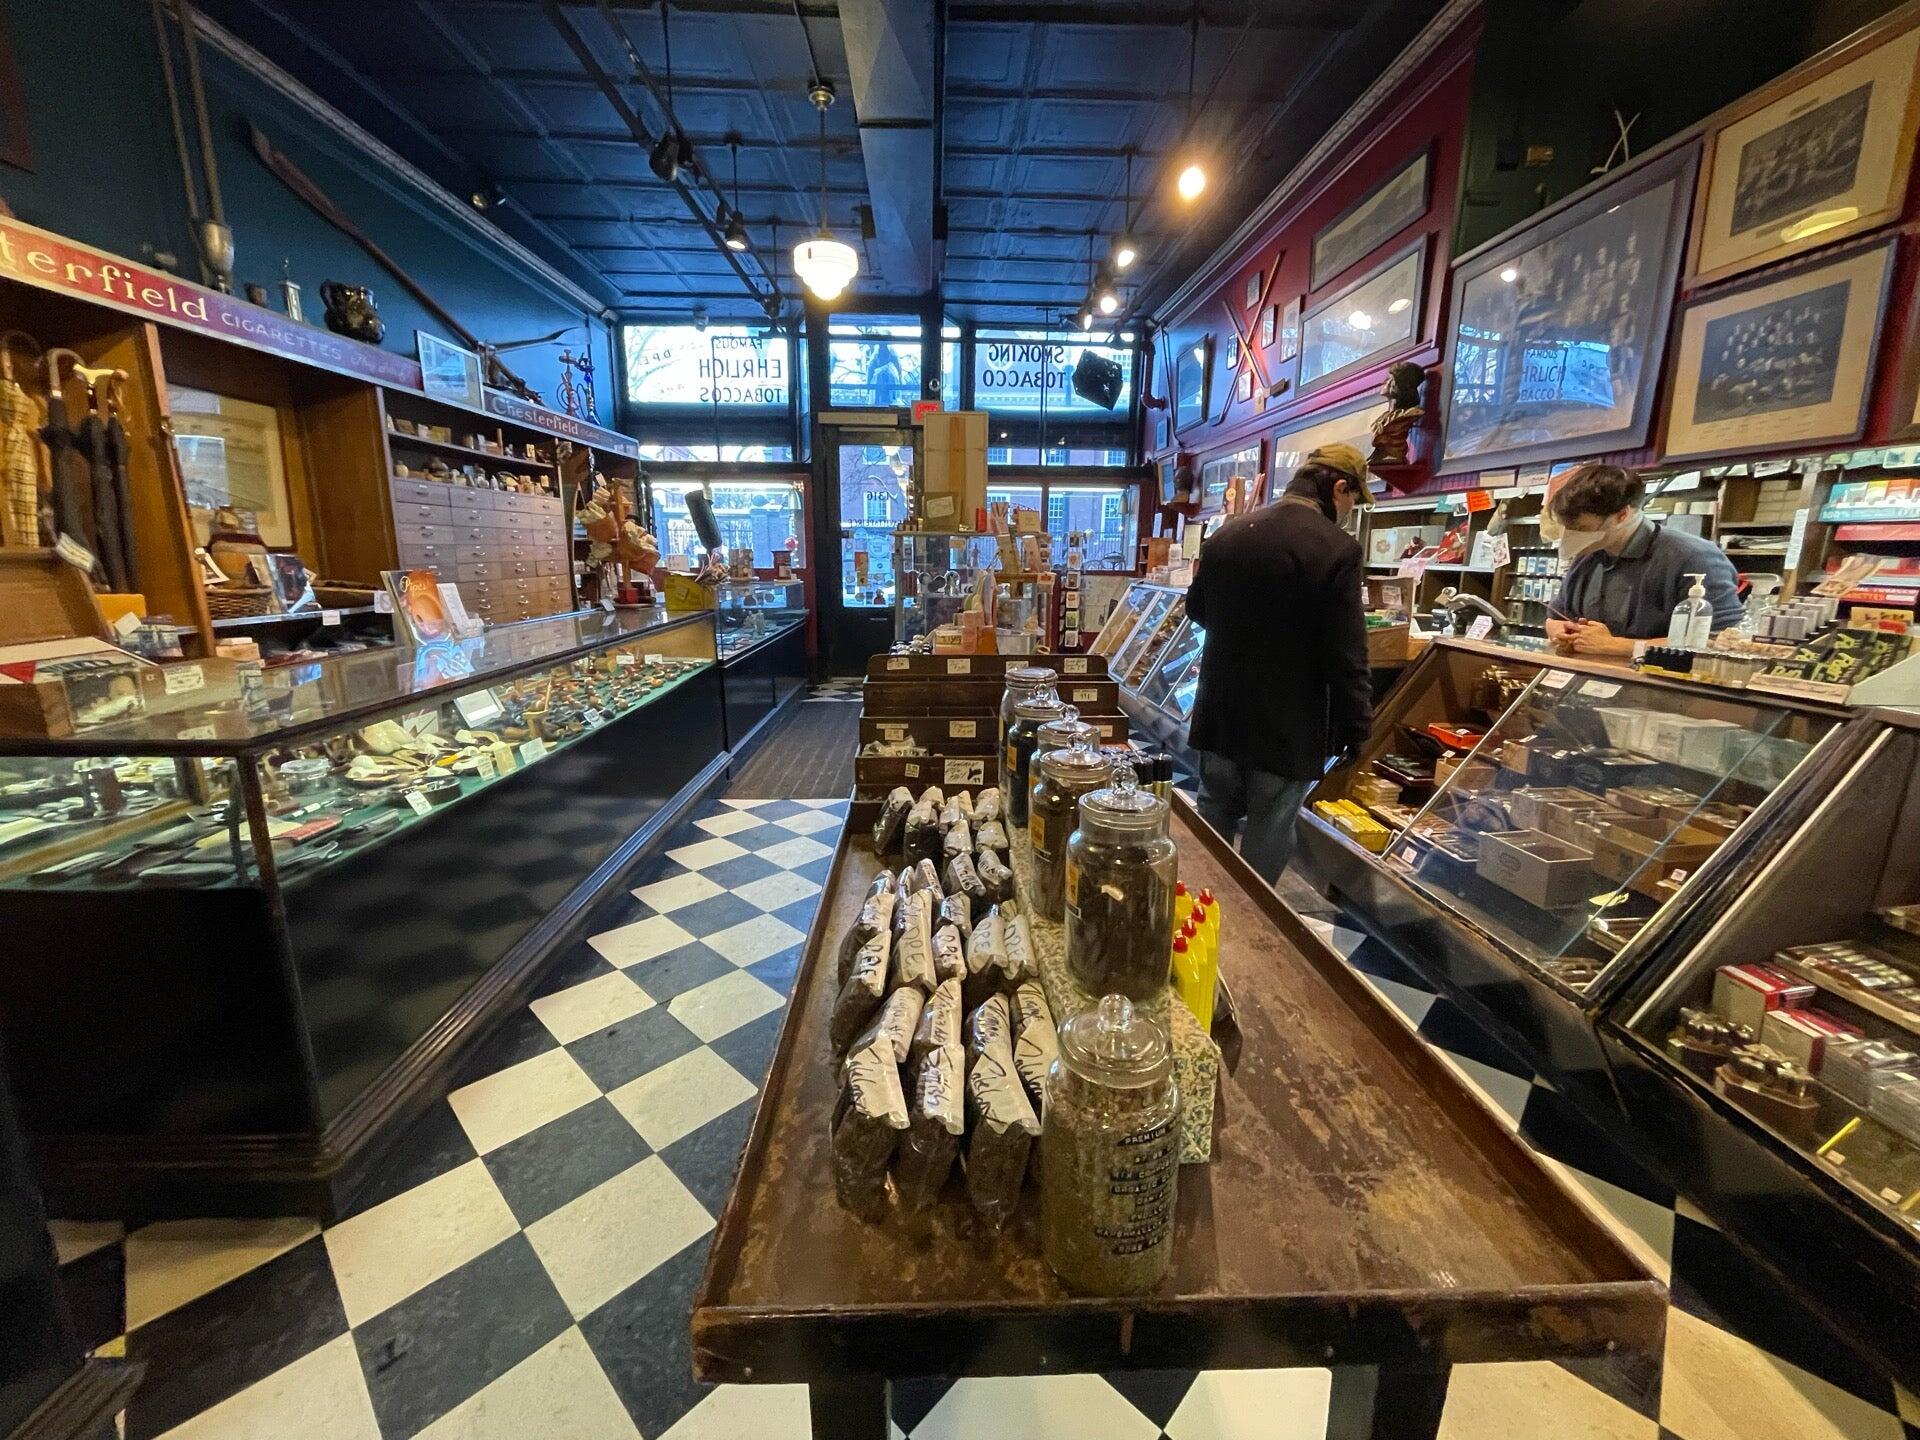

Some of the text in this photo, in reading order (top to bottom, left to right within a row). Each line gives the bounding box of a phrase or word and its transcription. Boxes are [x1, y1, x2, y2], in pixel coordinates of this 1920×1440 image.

[221, 312, 343, 361] CIGARETTES
[492, 396, 579, 435] Chesterfield
[1125, 1127, 1166, 1144] PREMIUM
